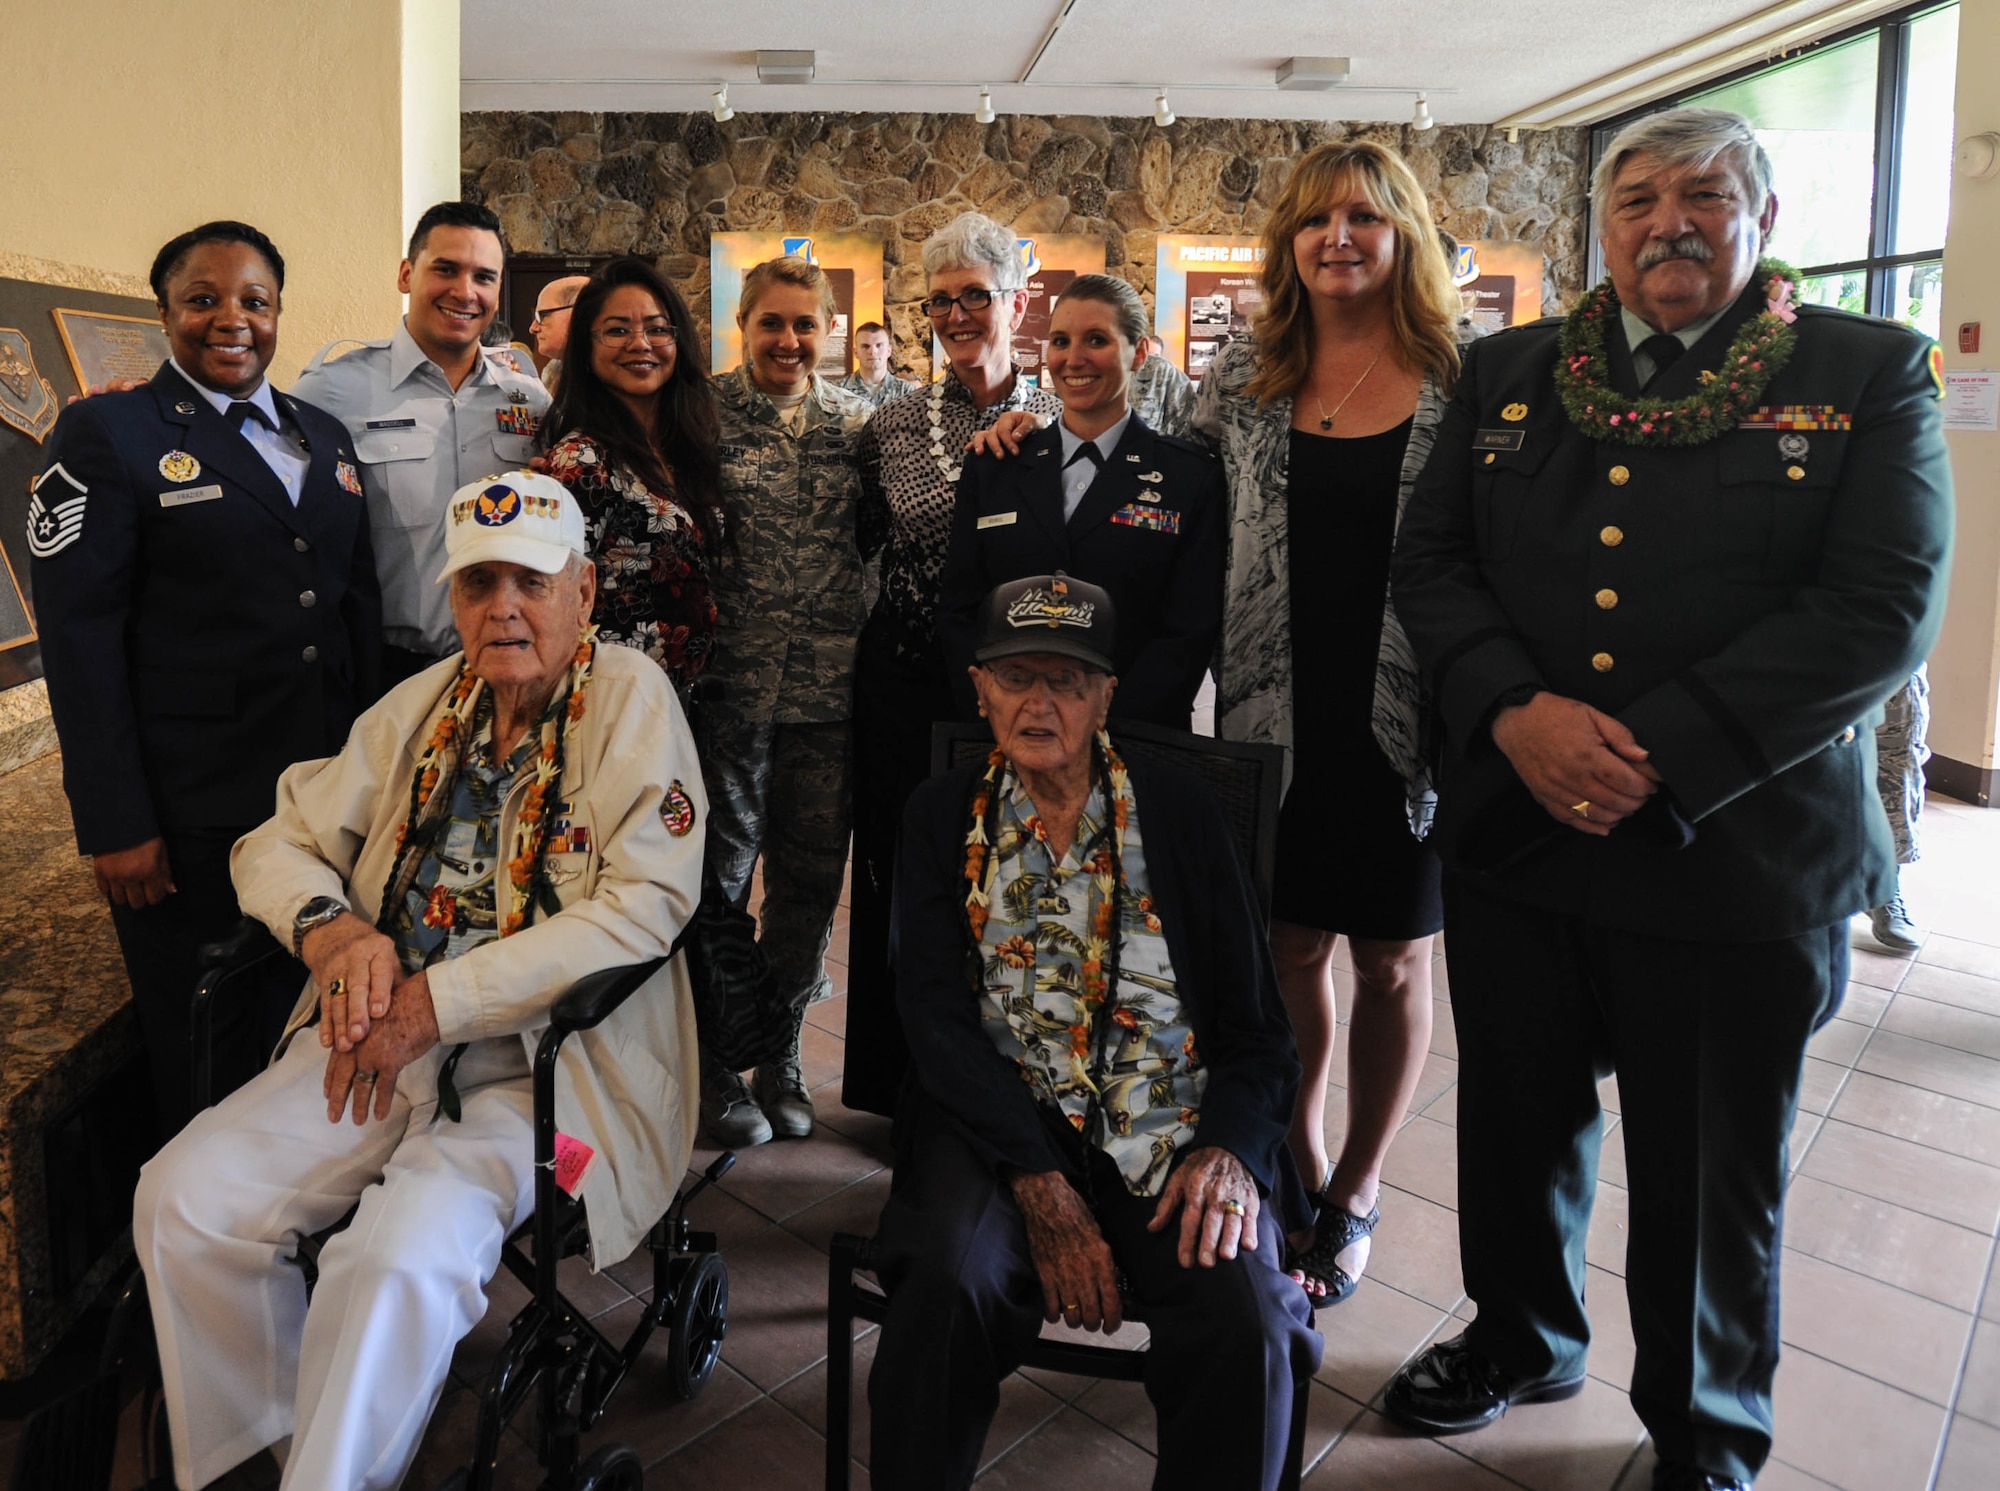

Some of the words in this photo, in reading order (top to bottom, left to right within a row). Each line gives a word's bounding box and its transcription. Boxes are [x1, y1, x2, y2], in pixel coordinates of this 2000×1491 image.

[1180, 246, 1230, 262] PACIFIC
[1231, 247, 1253, 262] AIR
[1029, 281, 1045, 289] Asia
[1220, 278, 1244, 286] Korean
[176, 490, 205, 500] FRAZIER
